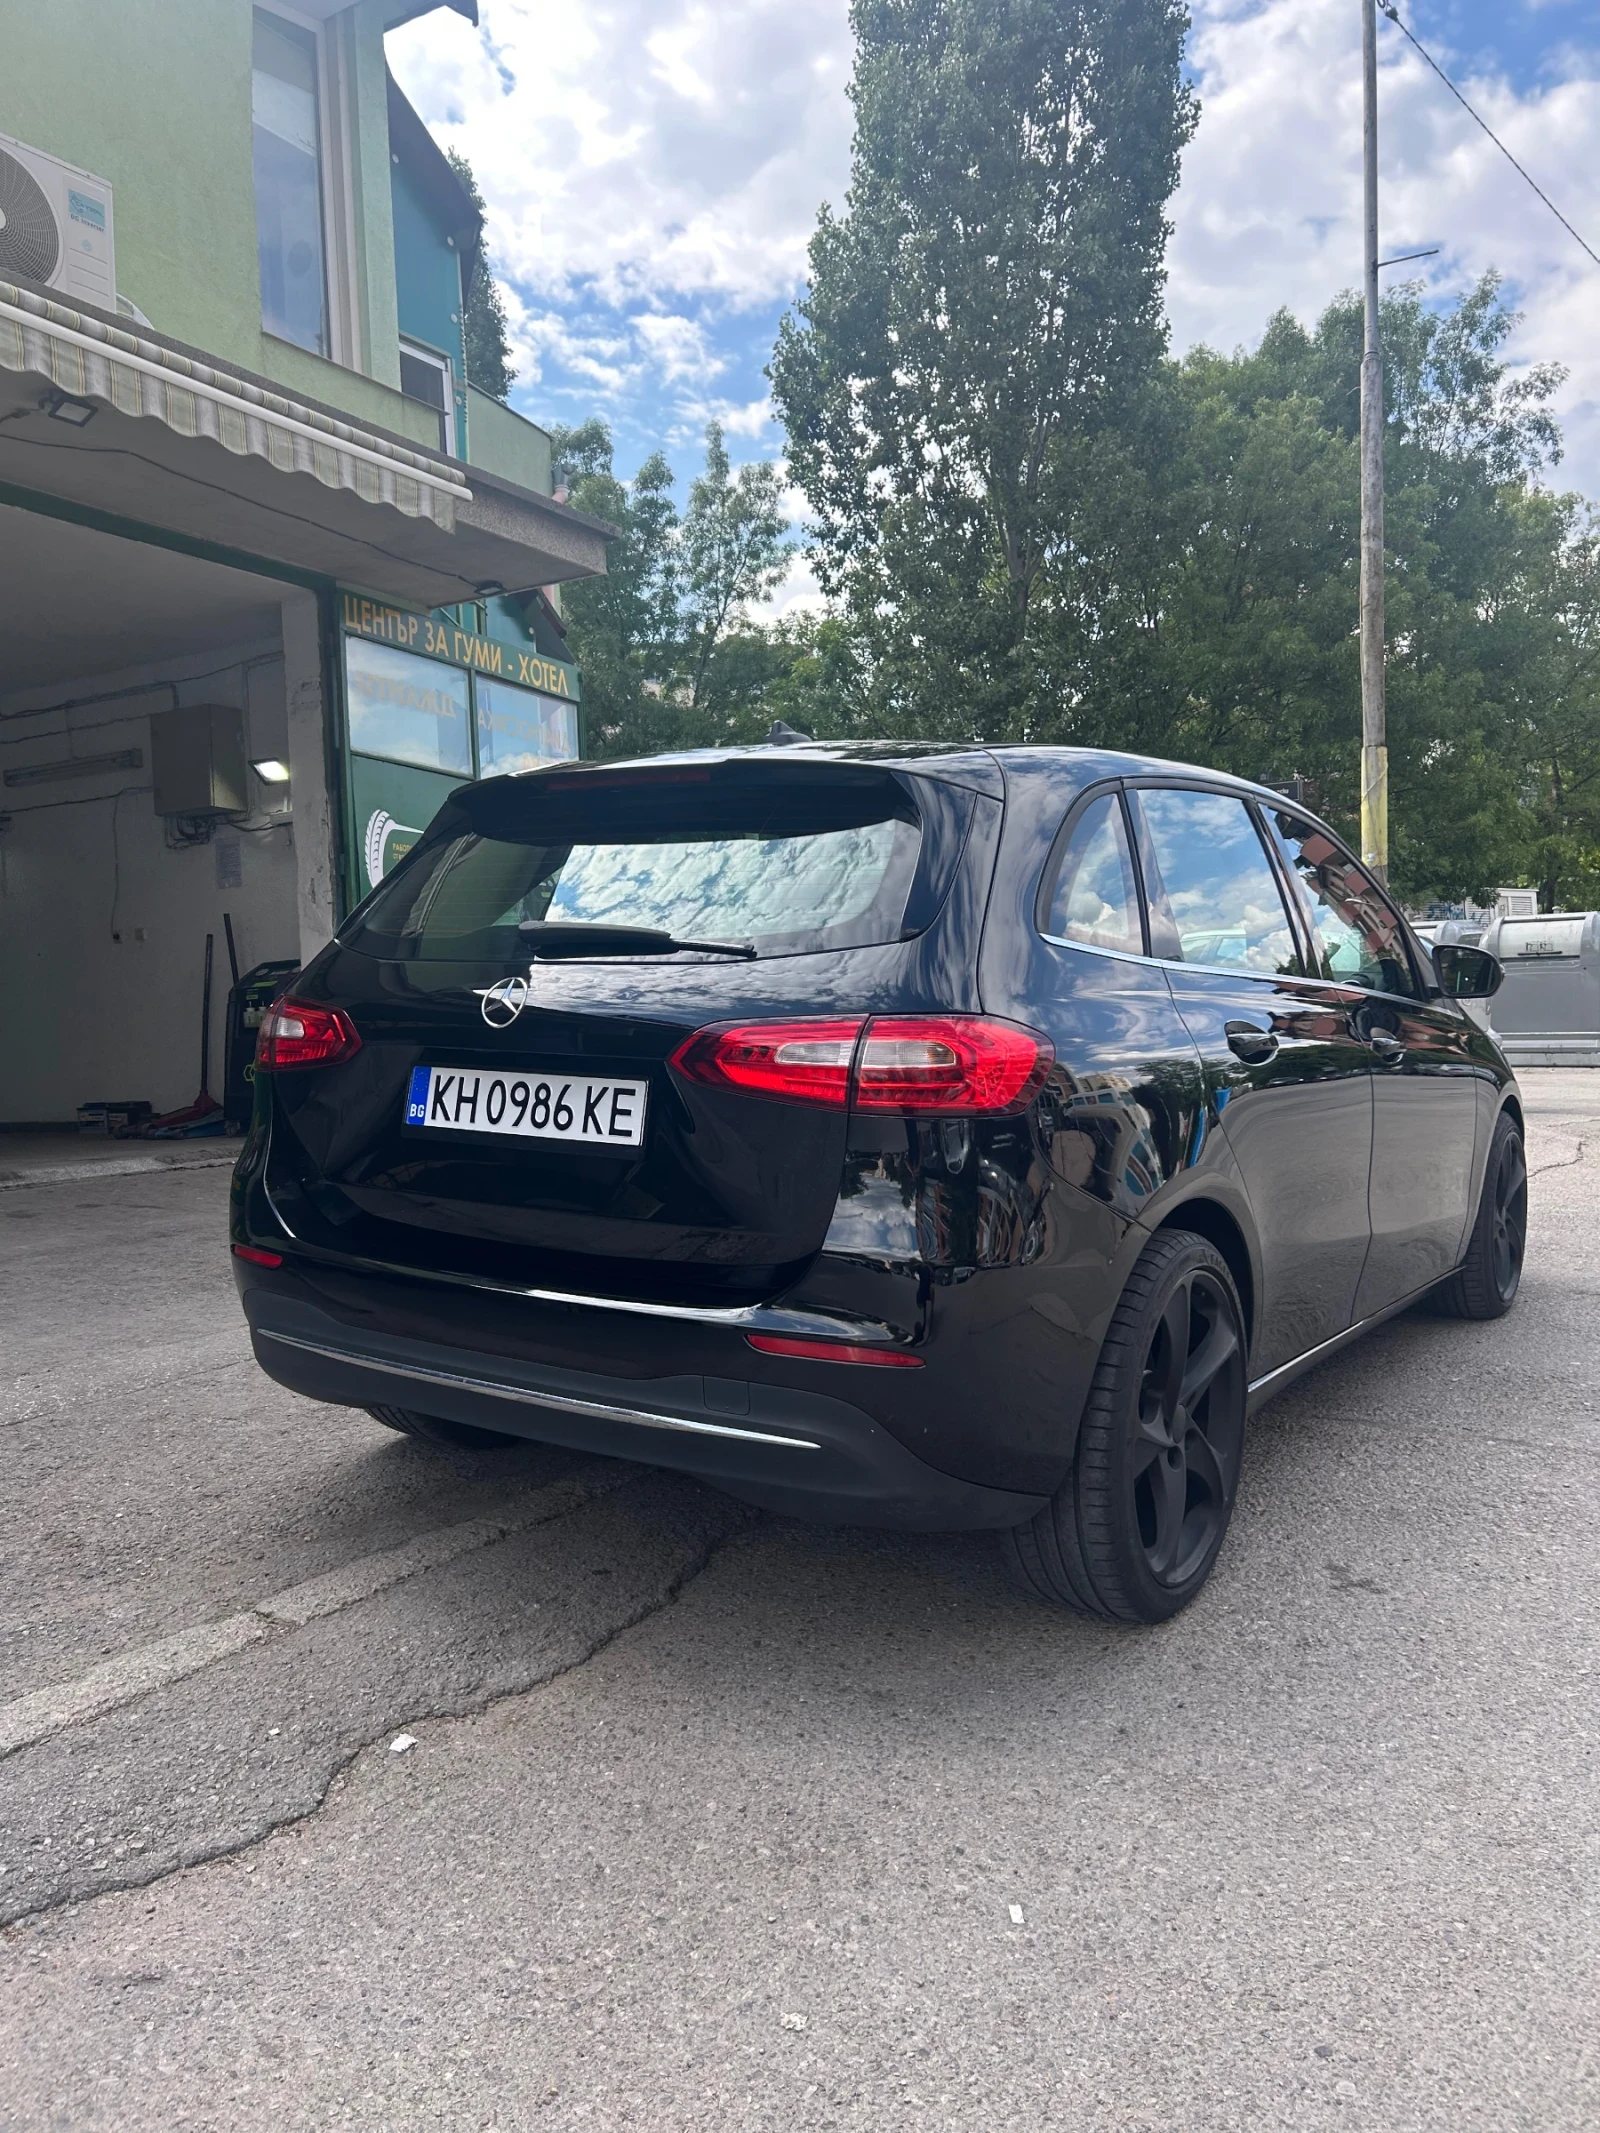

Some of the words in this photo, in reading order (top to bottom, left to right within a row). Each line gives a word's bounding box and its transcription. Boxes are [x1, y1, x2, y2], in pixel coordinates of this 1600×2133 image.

[344, 595, 418, 645] ЦЕНТЪР
[424, 621, 449, 657] ЗА
[454, 630, 502, 674] ГУМИ
[518, 653, 569, 696] ХОТЕЛ
[409, 1103, 425, 1118] BG
